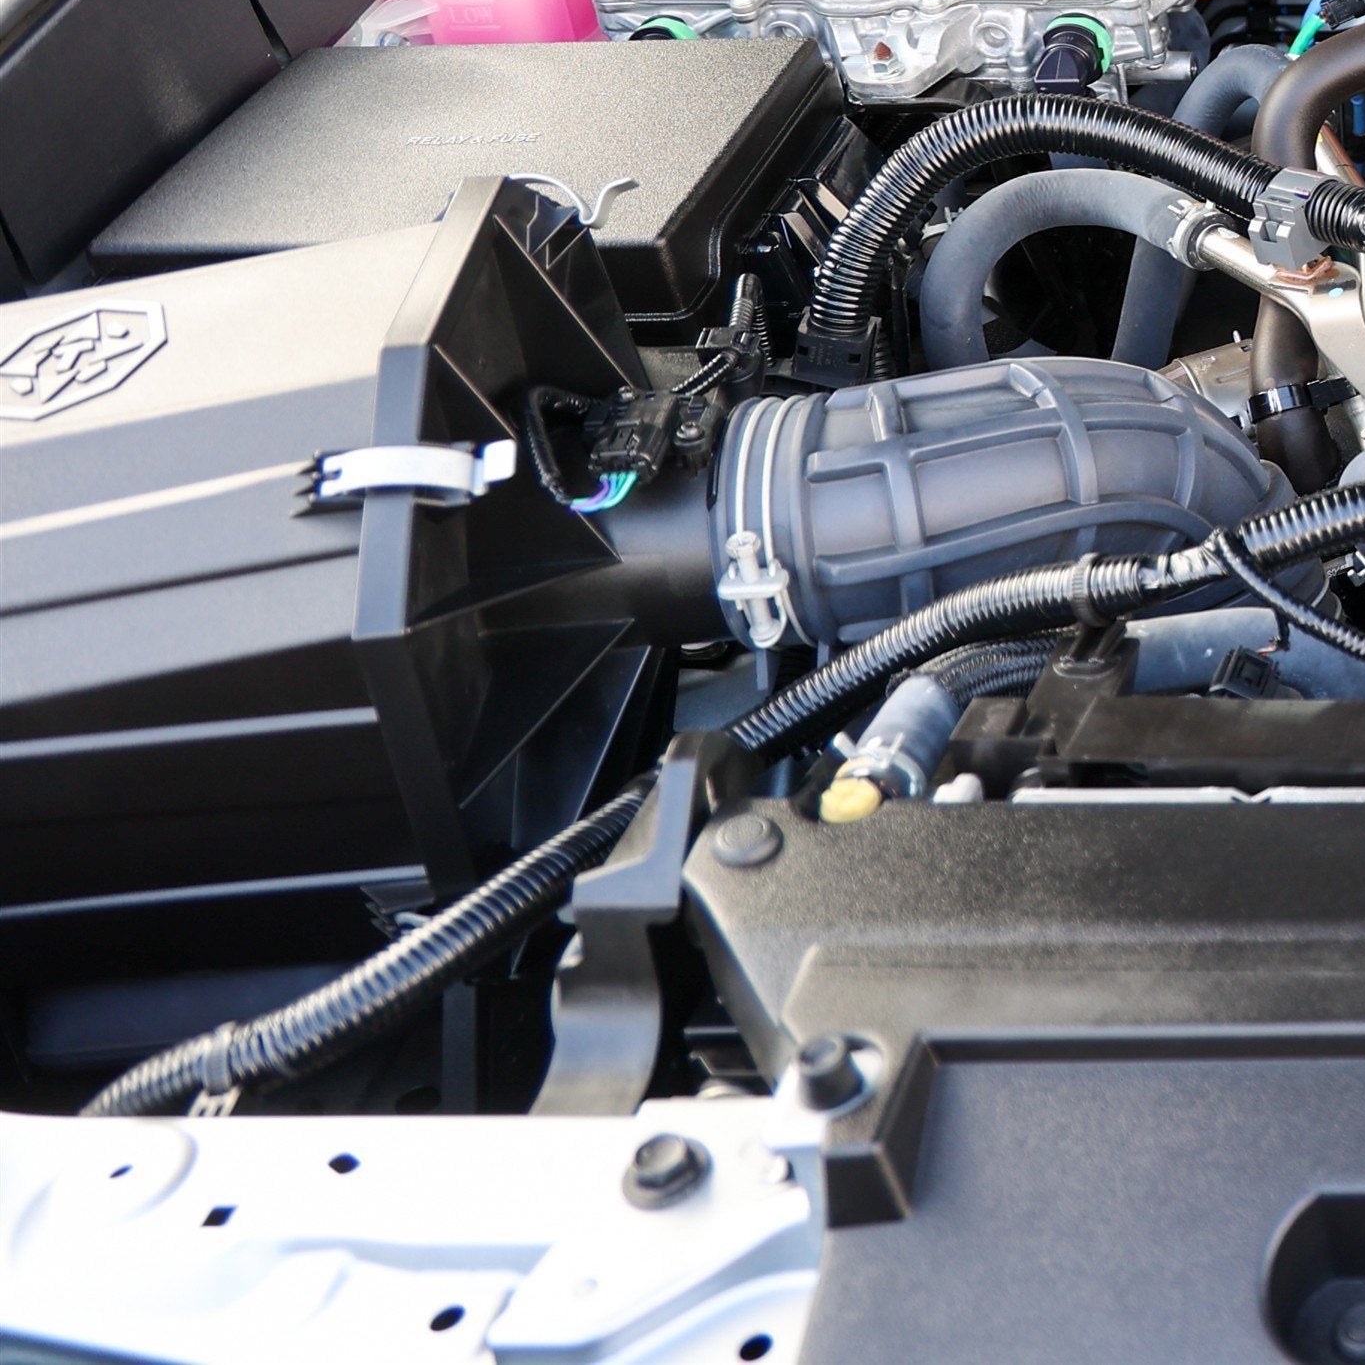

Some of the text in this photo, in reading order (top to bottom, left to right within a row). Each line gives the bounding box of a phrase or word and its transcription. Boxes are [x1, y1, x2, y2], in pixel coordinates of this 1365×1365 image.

[449, 6, 494, 25] LOW
[406, 135, 470, 146] RELAY
[489, 132, 541, 144] FUSE
